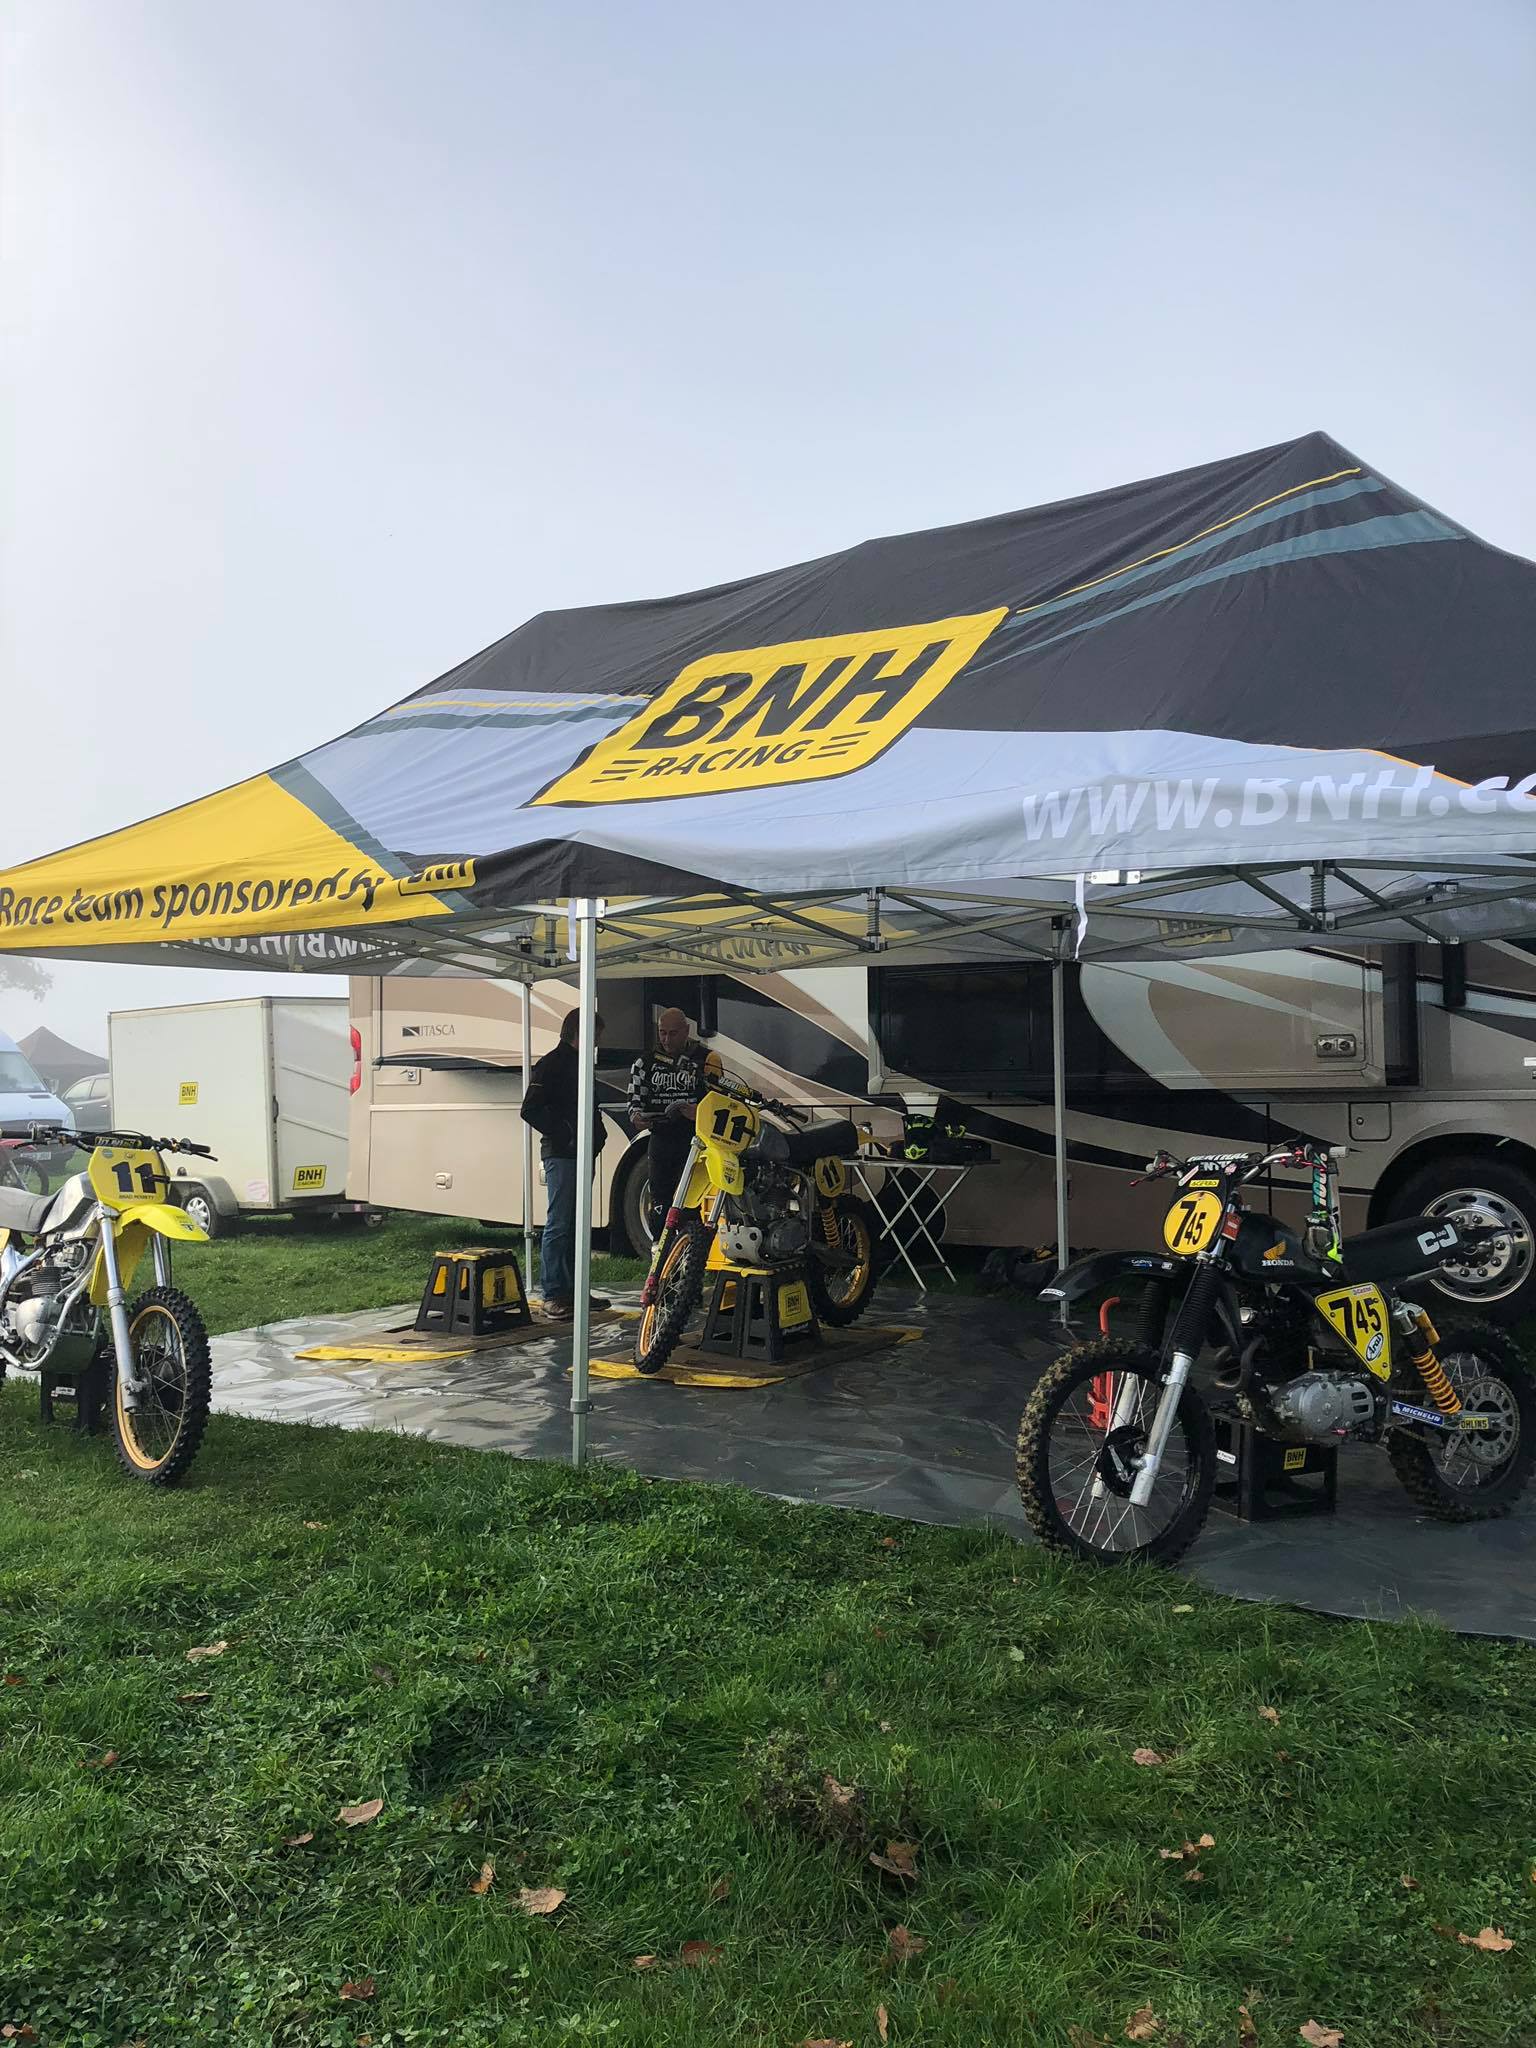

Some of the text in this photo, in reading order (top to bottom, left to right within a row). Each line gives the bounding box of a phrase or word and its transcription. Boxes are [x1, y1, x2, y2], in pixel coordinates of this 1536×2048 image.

[629, 639, 955, 750] BNH
[639, 739, 815, 779] RACING
[0, 887, 63, 926] Race
[63, 887, 144, 923] team
[150, 868, 349, 928] sponsored
[420, 1024, 456, 1037] ITASCA
[181, 1085, 197, 1097] BNH
[714, 1108, 747, 1143] 11
[112, 1161, 157, 1194] 11
[298, 1168, 323, 1181] BNH
[1172, 1201, 1207, 1248] 745
[1262, 1259, 1295, 1267] HONDA
[1328, 1296, 1382, 1346] 745
[1367, 1336, 1382, 1356] Arai
[1401, 1406, 1441, 1422] MICHELIN
[1286, 1449, 1305, 1462] BNH
